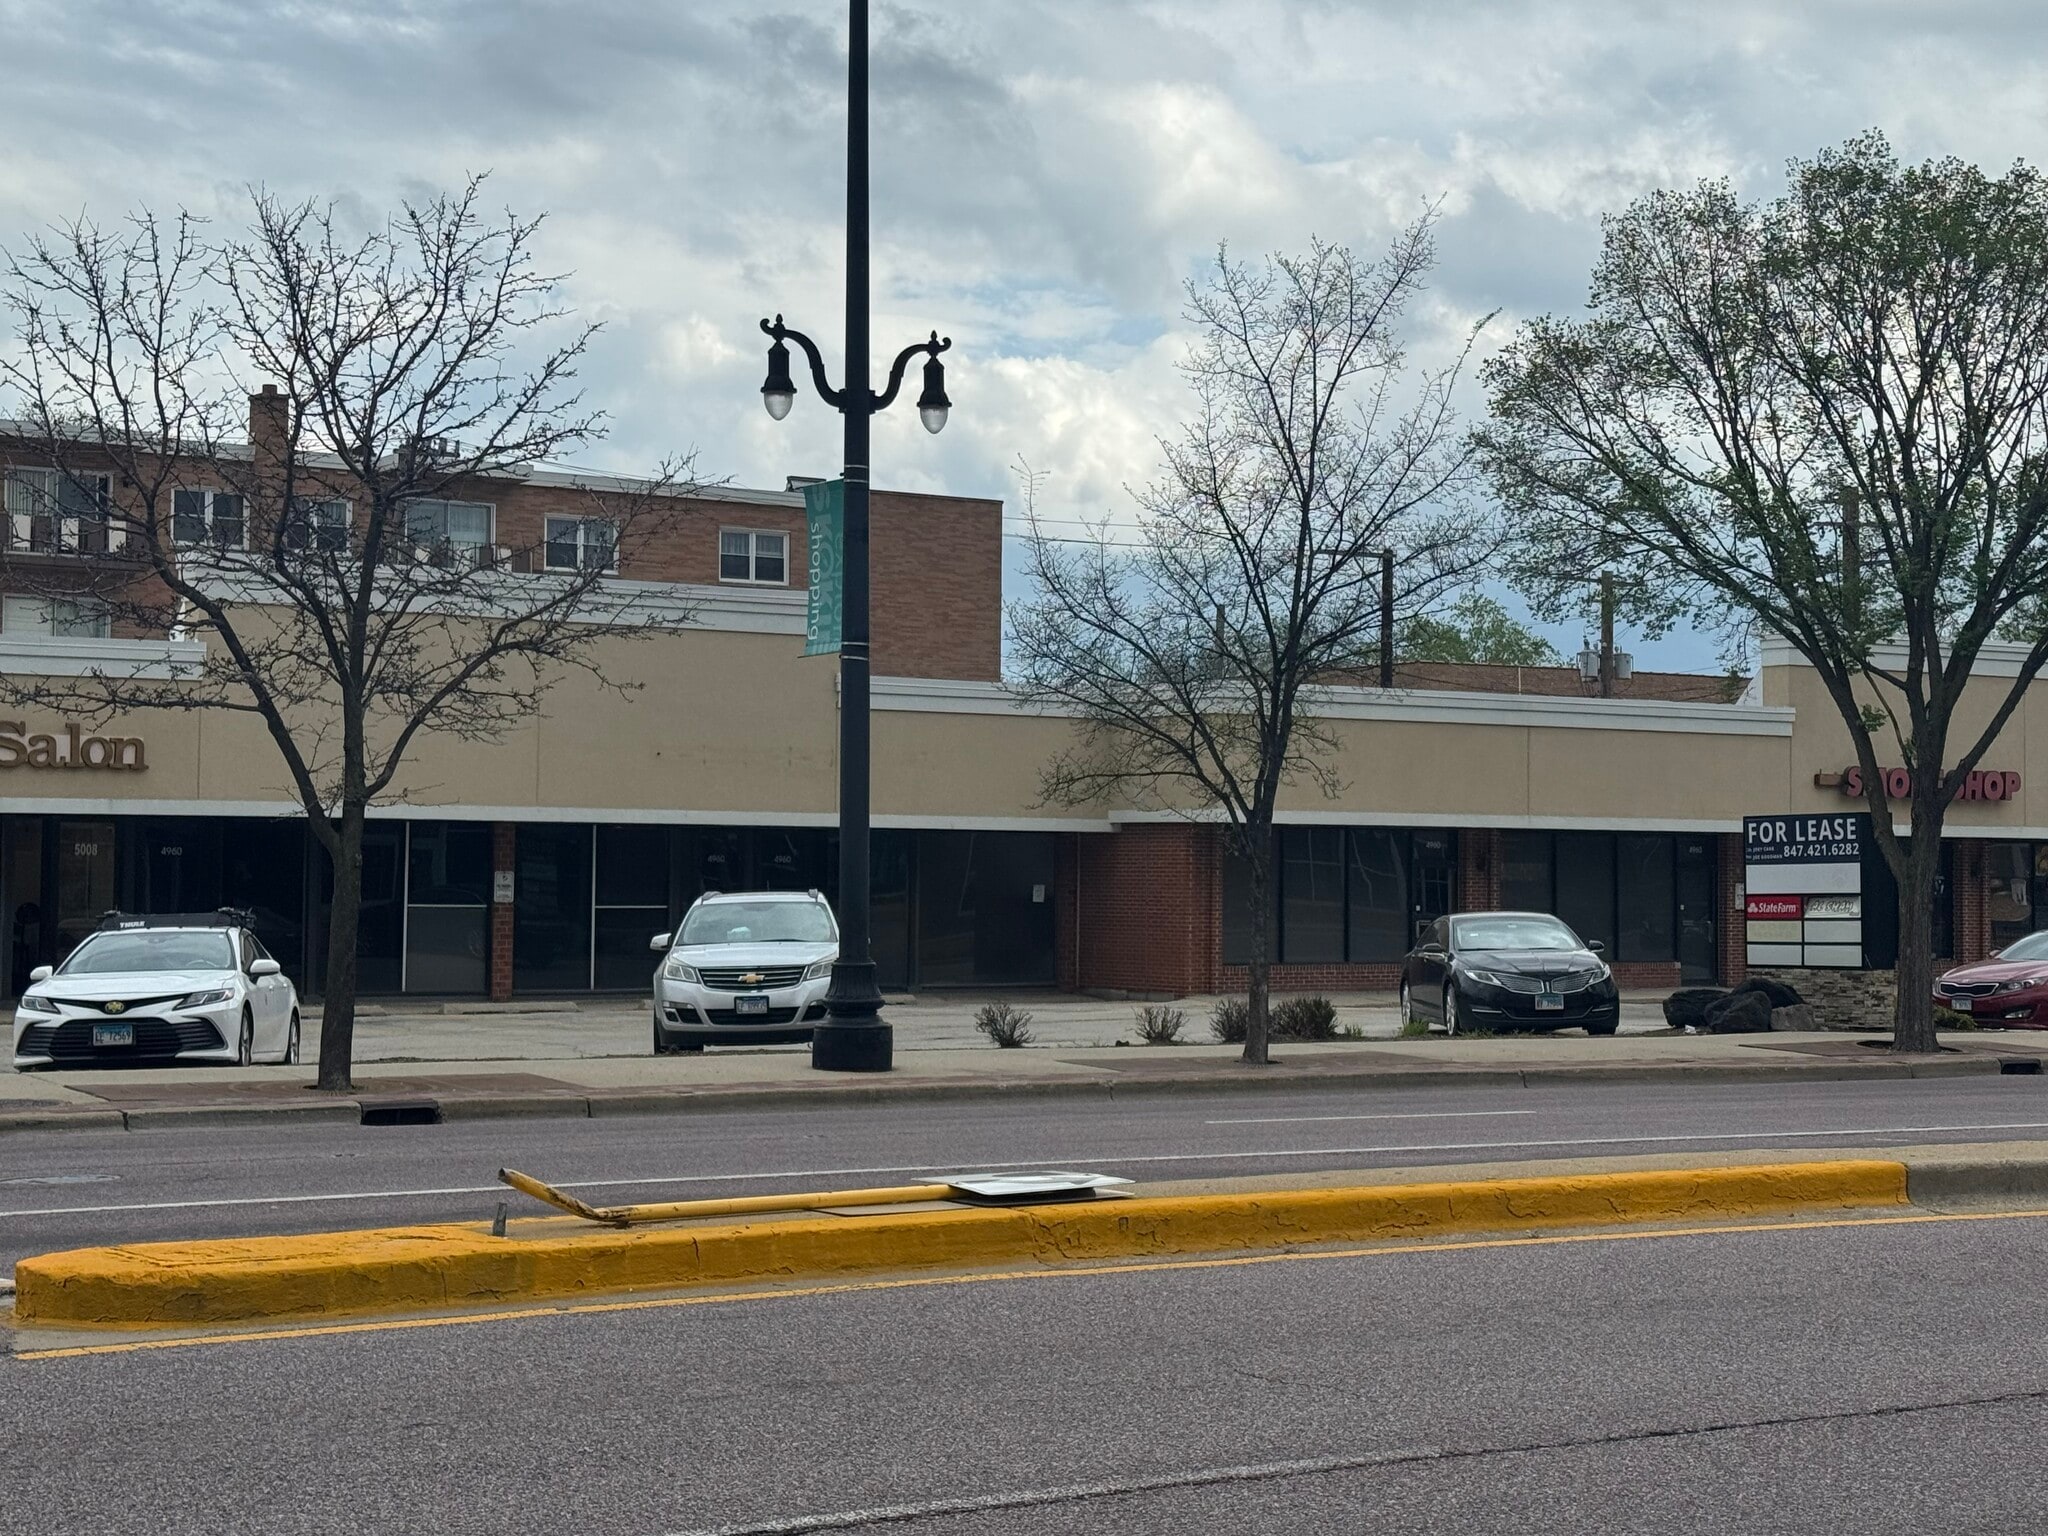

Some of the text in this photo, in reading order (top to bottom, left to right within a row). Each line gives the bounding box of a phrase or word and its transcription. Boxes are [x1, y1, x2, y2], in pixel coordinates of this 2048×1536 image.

[808, 522, 823, 640] shopping
[0, 720, 149, 769] Salon
[1953, 770, 2021, 801] HOP
[1748, 818, 1857, 843] FOR LEASE
[74, 843, 98, 856] 5008
[160, 846, 183, 856] 4960
[1783, 843, 1859, 857] 847.421.6282
[119, 920, 145, 928] THULE
